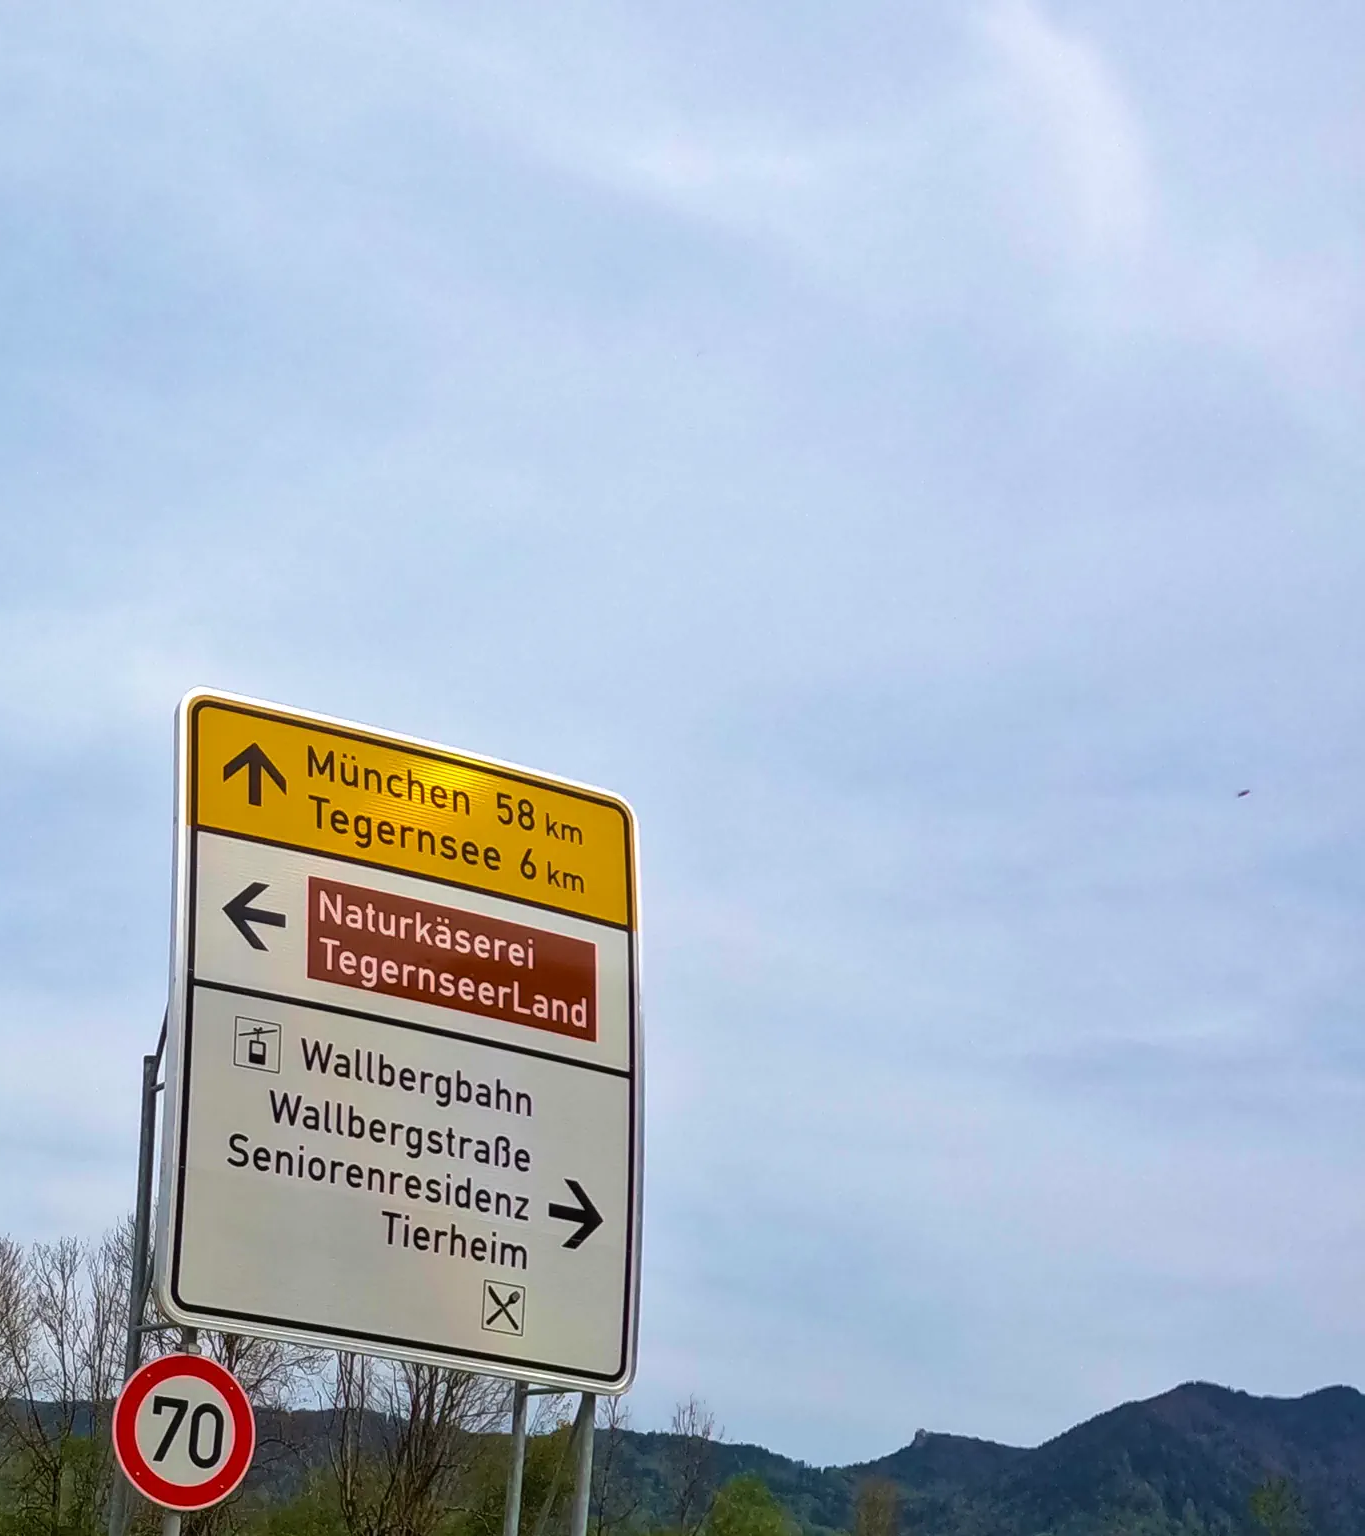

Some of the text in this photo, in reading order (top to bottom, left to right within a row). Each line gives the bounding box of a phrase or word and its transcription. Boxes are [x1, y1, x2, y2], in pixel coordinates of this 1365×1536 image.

[307, 744, 584, 846] München 58 km
[307, 794, 585, 894] Tegernsee 6 km
[318, 889, 535, 970] Naturkäserei
[318, 936, 589, 1030] TegernseerLand
[300, 1037, 533, 1118] Wallbergbahn
[268, 1089, 531, 1173] Wallbergstraße
[226, 1132, 530, 1222] Seniorenresidenz
[380, 1210, 528, 1271] Tierheim
[152, 1395, 225, 1469] 70
